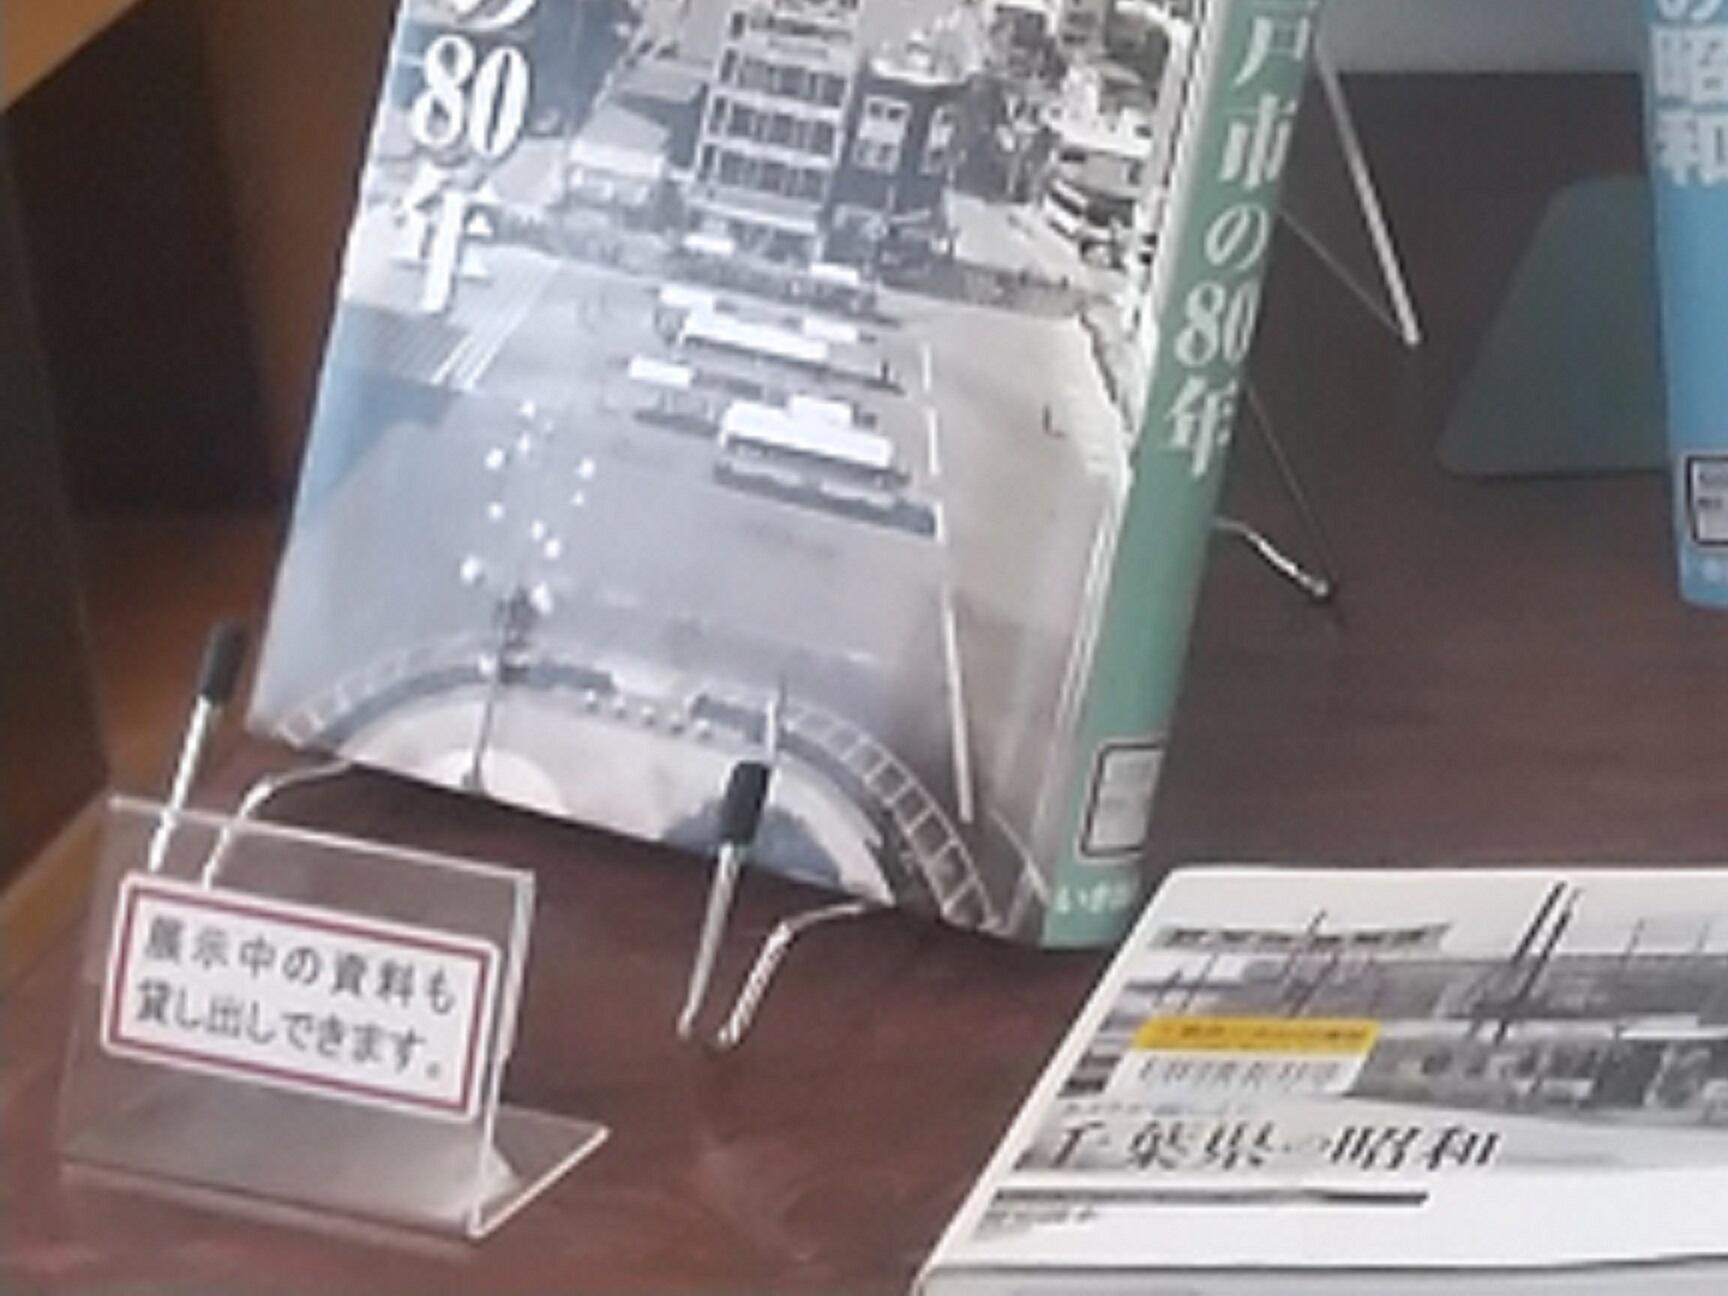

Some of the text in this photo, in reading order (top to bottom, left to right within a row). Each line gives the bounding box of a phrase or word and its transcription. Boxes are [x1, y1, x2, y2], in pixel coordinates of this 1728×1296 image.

[143, 913, 457, 1016] 展示中の資料も
[133, 978, 448, 1080] 貸し出しできます。
